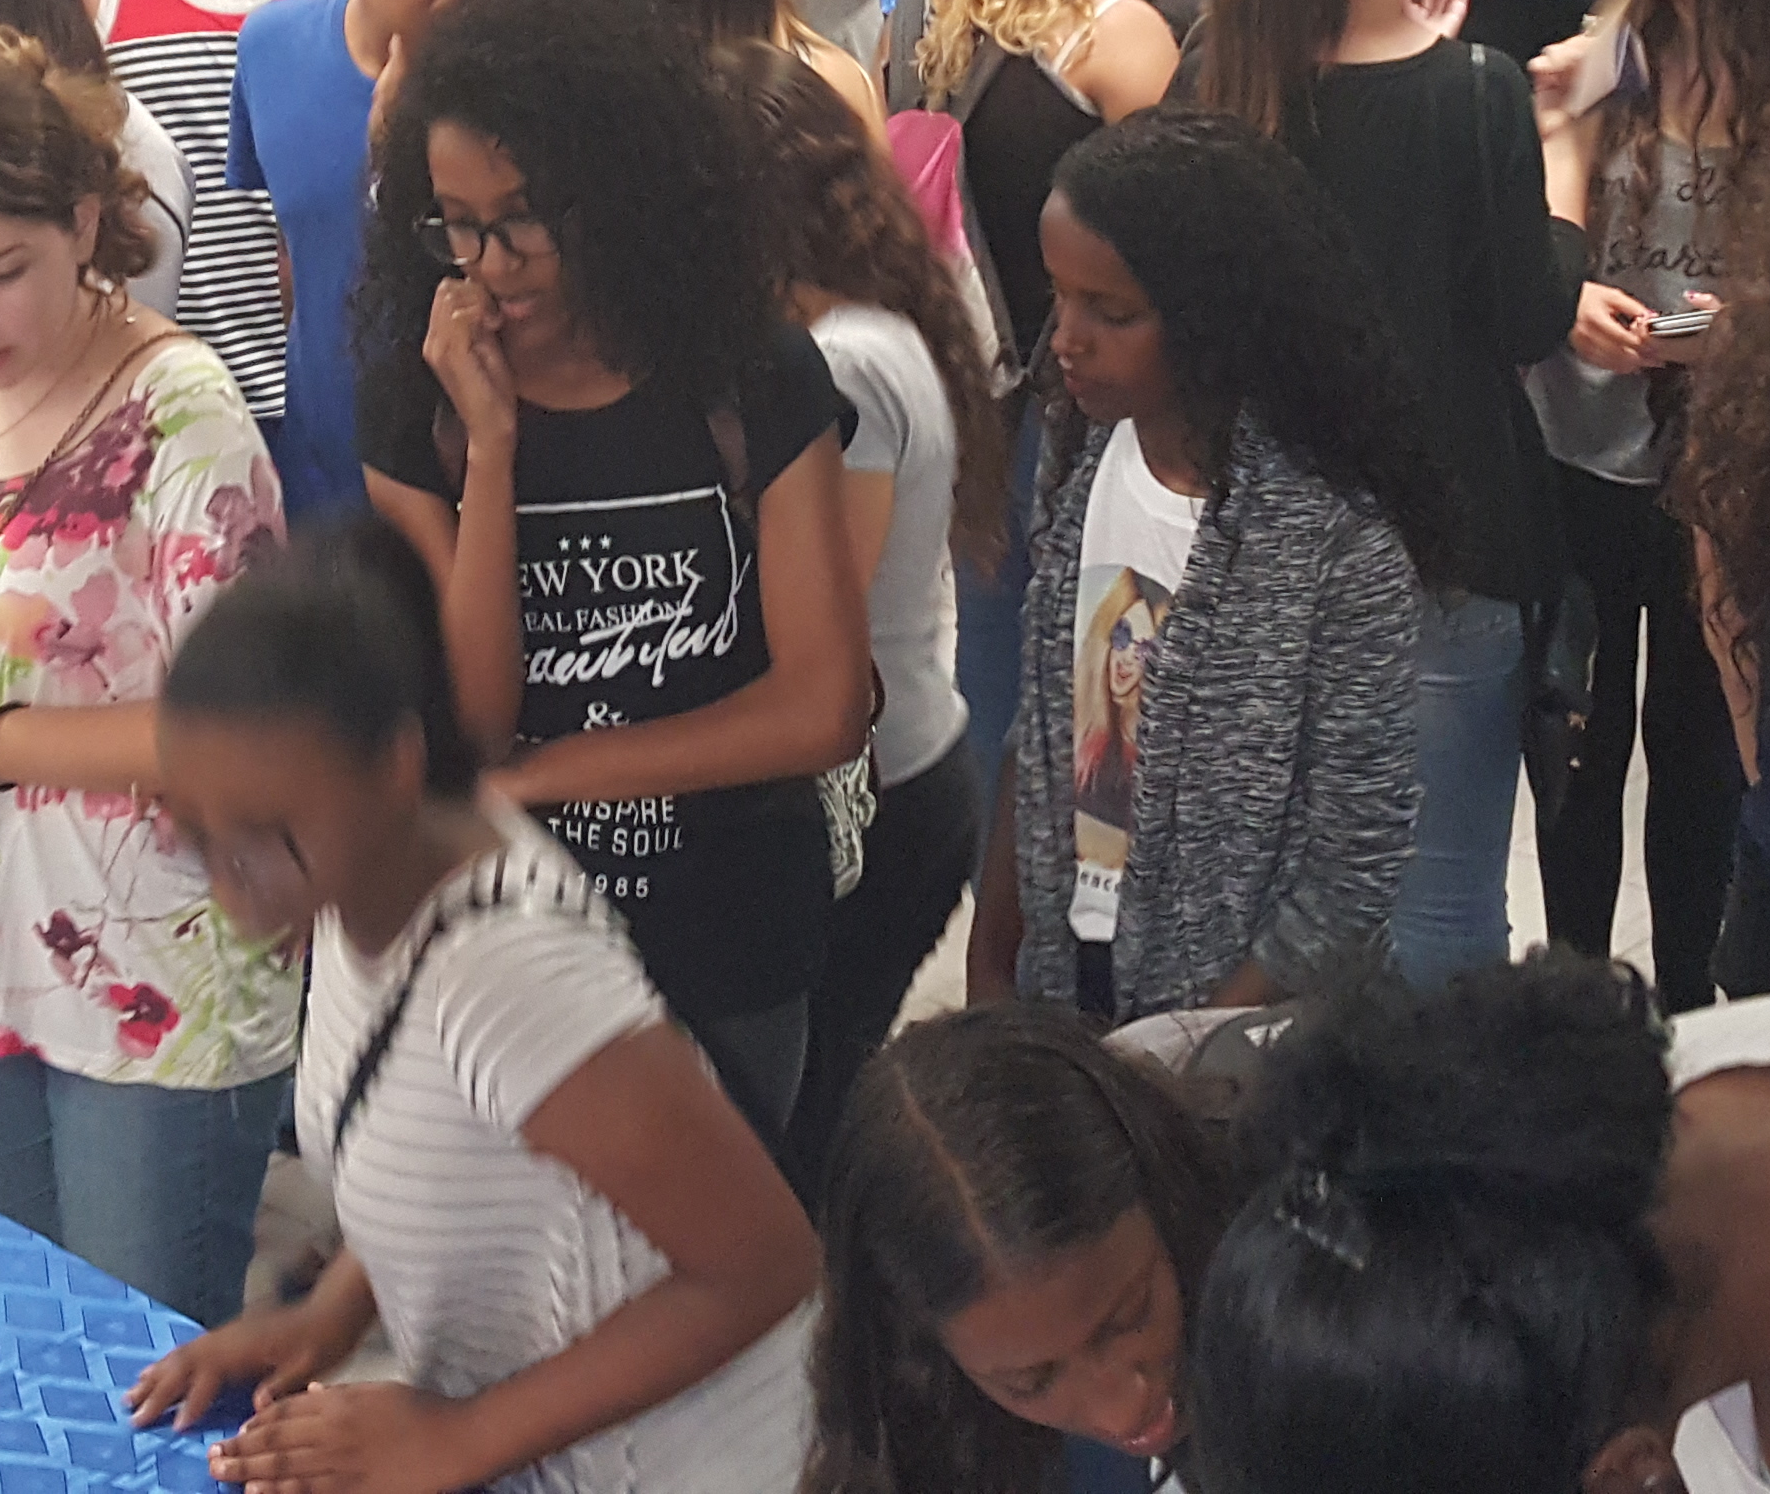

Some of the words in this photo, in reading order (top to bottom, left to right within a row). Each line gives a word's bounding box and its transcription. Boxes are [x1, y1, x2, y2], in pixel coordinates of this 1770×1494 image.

[519, 560, 571, 598] EW
[579, 548, 706, 594] YORK
[524, 611, 571, 633] EAL
[548, 816, 602, 851] THE
[612, 826, 684, 857] SOUL
[579, 870, 650, 899] 1985
